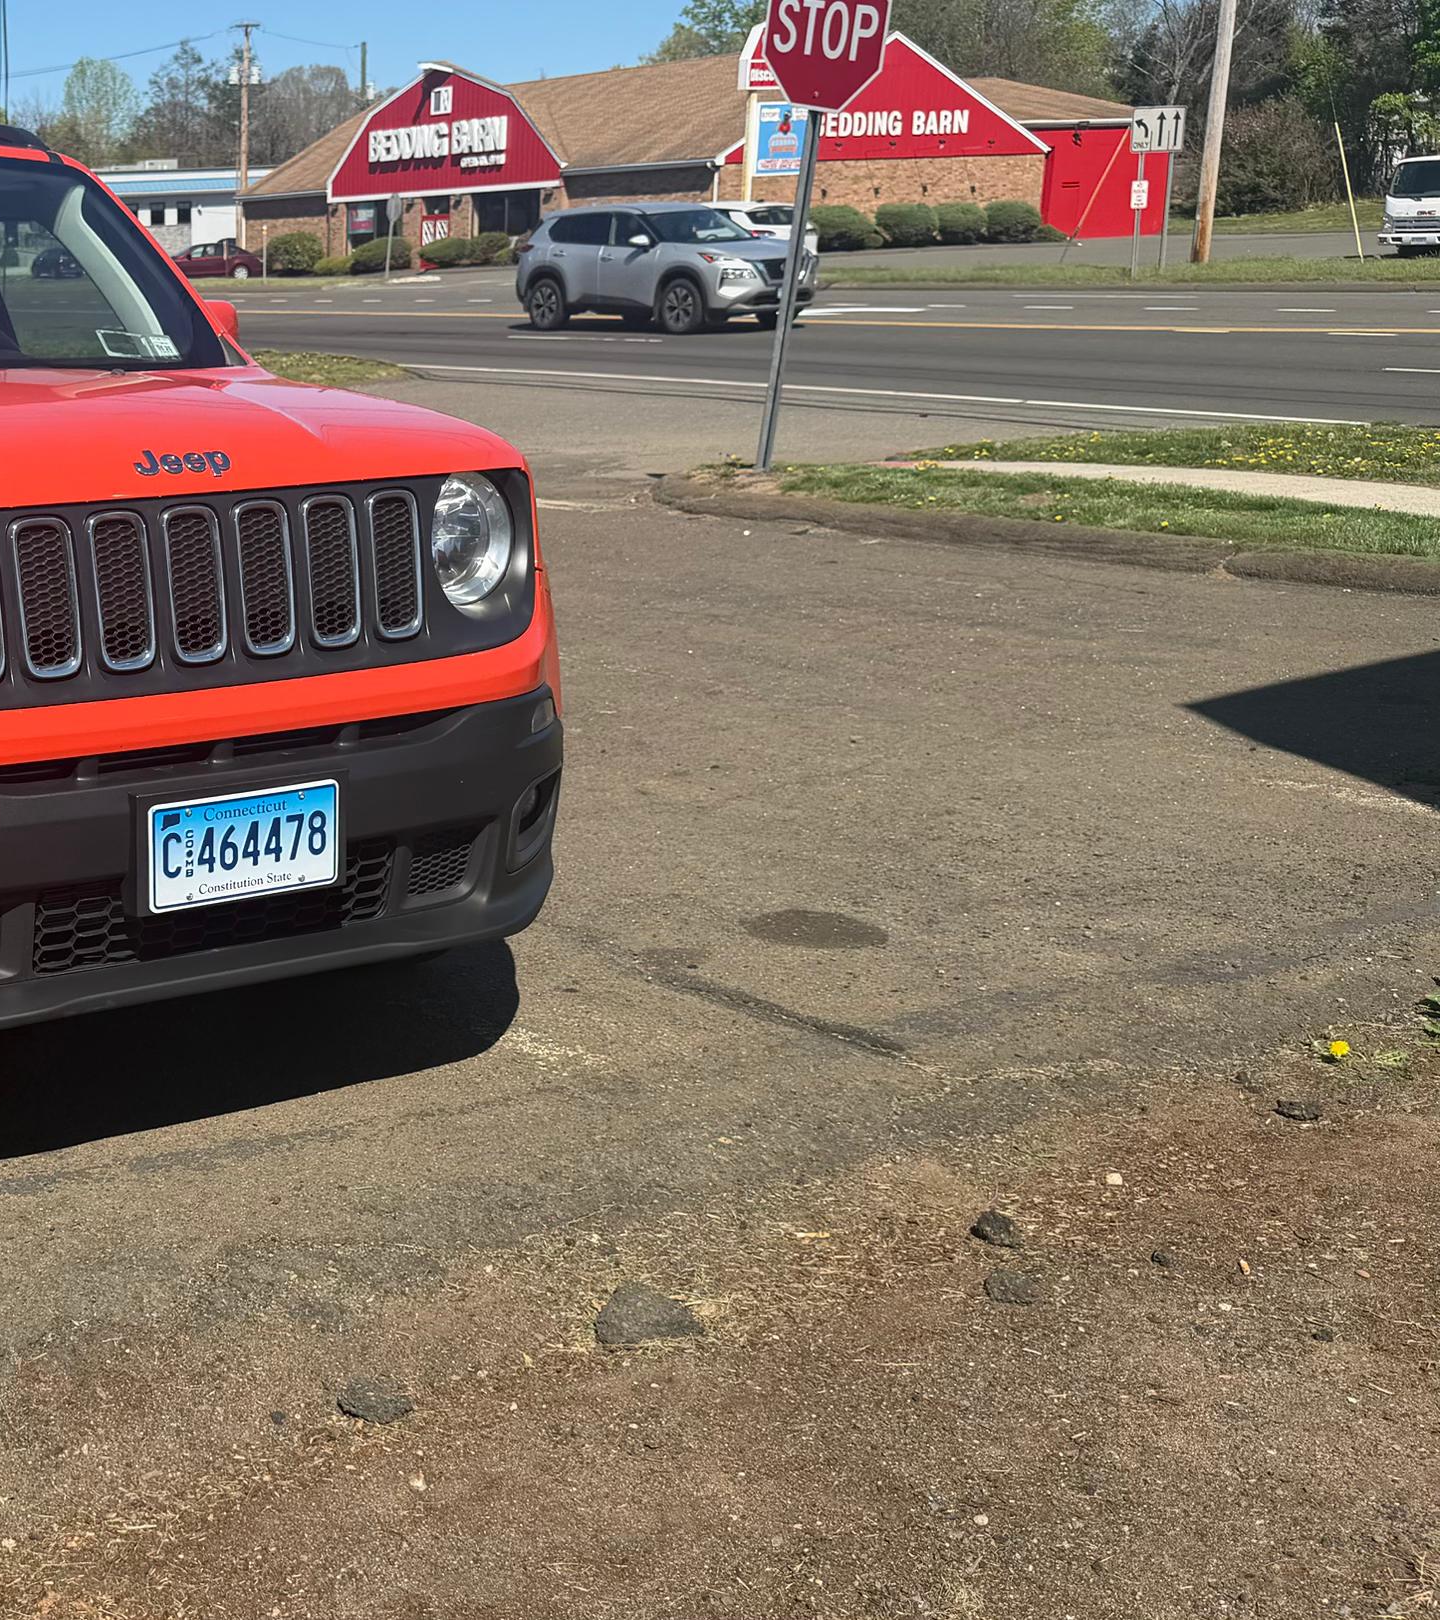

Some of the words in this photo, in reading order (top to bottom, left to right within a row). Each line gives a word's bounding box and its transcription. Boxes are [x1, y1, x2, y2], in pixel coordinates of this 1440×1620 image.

[773, 0, 880, 62] STOP
[912, 109, 969, 136] BARN
[369, 122, 449, 162] BEDDING
[451, 115, 508, 154] BARN
[134, 450, 231, 478] Jeep
[203, 799, 288, 822] Connecticut
[197, 810, 327, 873] 464478
[198, 876, 264, 896] Constitution
[266, 871, 293, 885] State
